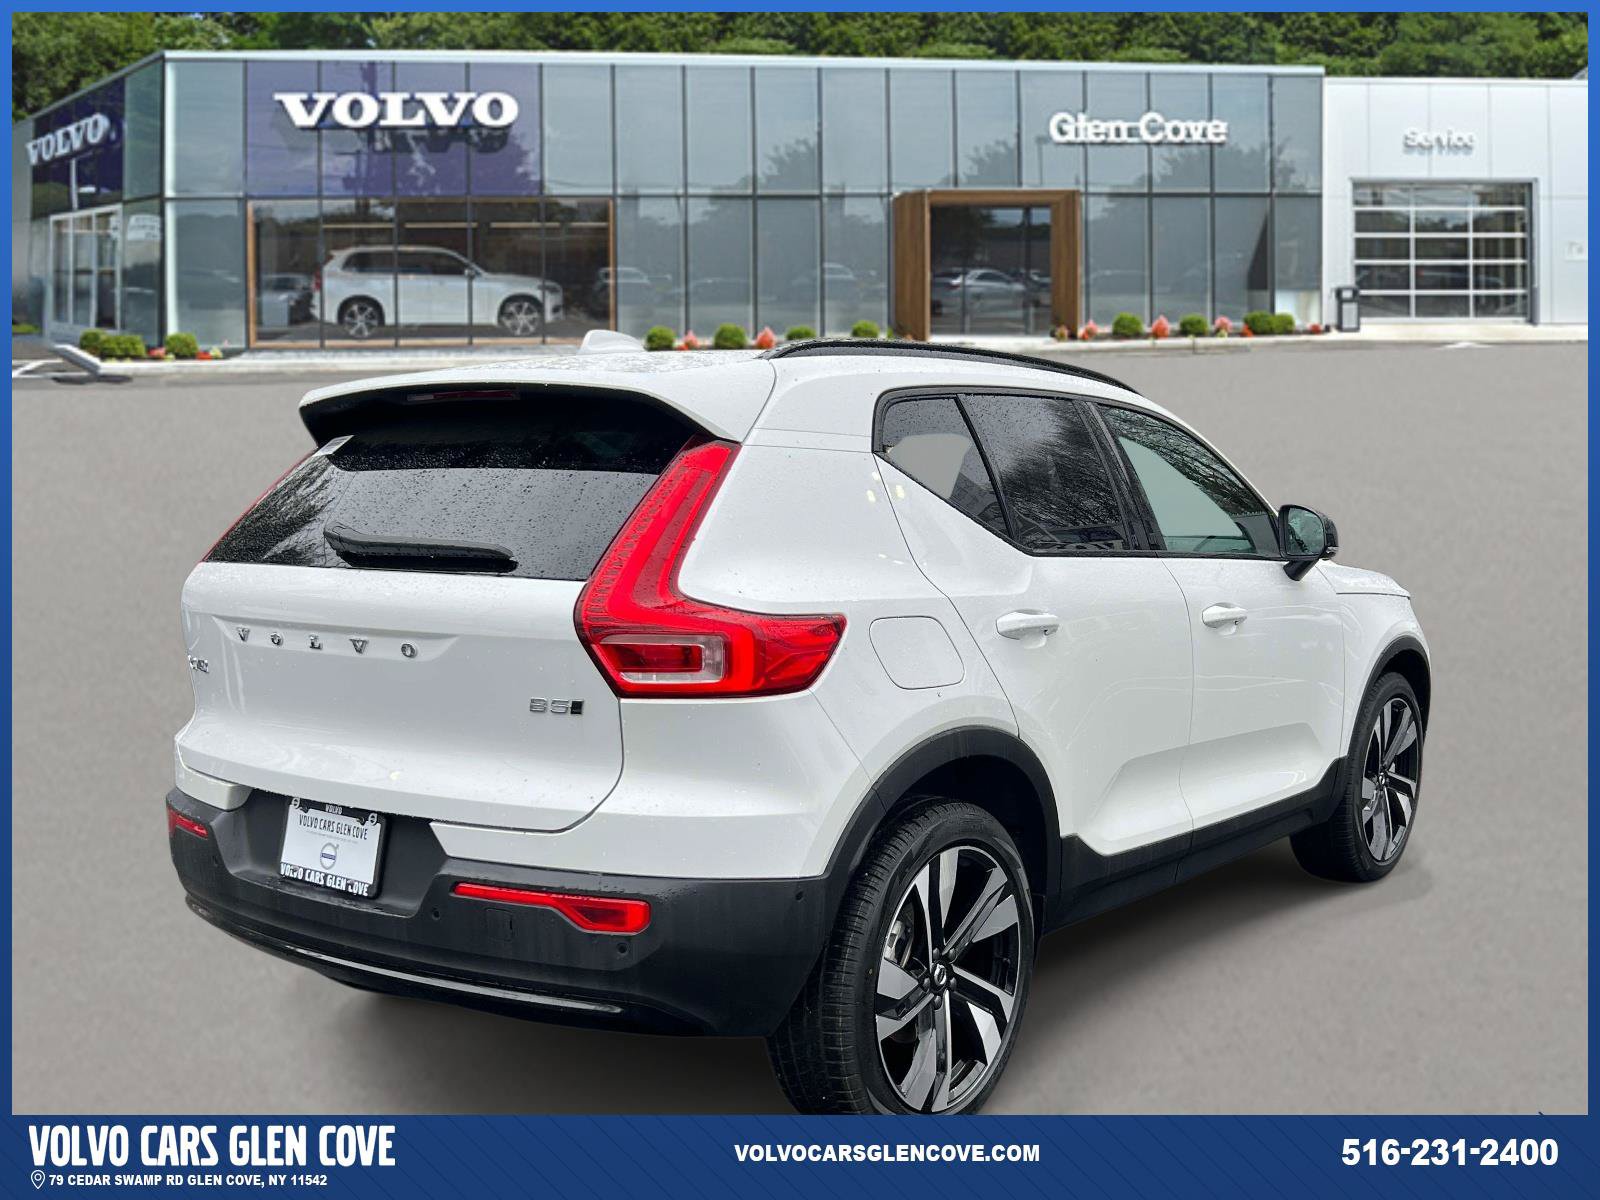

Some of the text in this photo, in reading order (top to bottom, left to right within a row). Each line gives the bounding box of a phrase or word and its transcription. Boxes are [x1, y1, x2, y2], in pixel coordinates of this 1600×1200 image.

[273, 92, 519, 128] VOLVO
[25, 113, 110, 166] VOLVO
[1049, 112, 1228, 143] Glen Cove
[1402, 127, 1475, 151] Service
[236, 626, 419, 660] VOLVO
[299, 813, 318, 830] VOLVO
[319, 818, 335, 833] CARS
[336, 822, 352, 837] GLEN
[352, 826, 368, 840] COVE
[304, 869, 325, 885] CARS
[326, 875, 347, 891] GLEN
